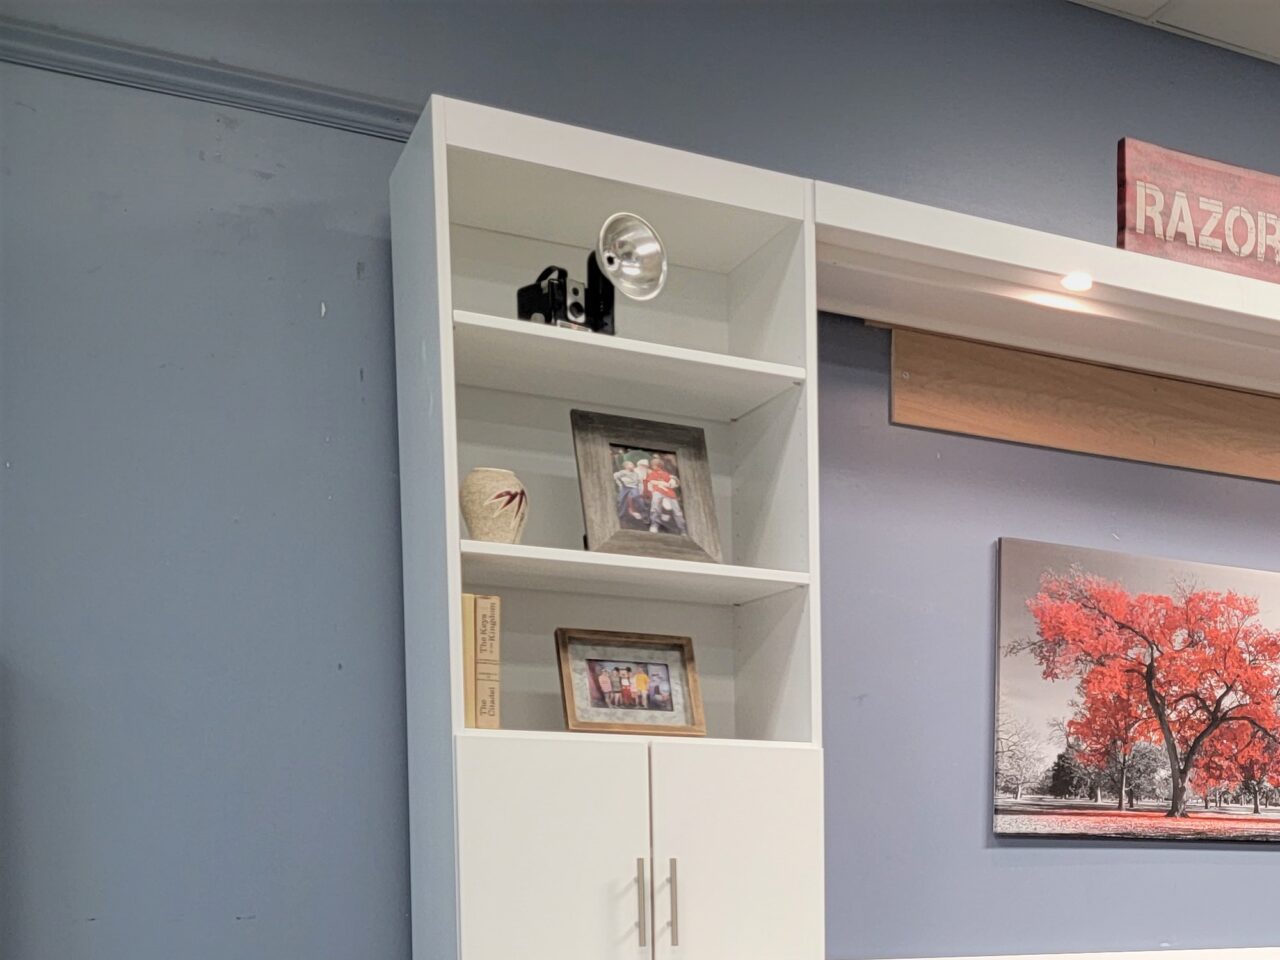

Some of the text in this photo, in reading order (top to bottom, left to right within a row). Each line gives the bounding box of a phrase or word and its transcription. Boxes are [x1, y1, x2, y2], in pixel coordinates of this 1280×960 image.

[480, 613, 488, 654] The Keys
[480, 699, 488, 716] The
